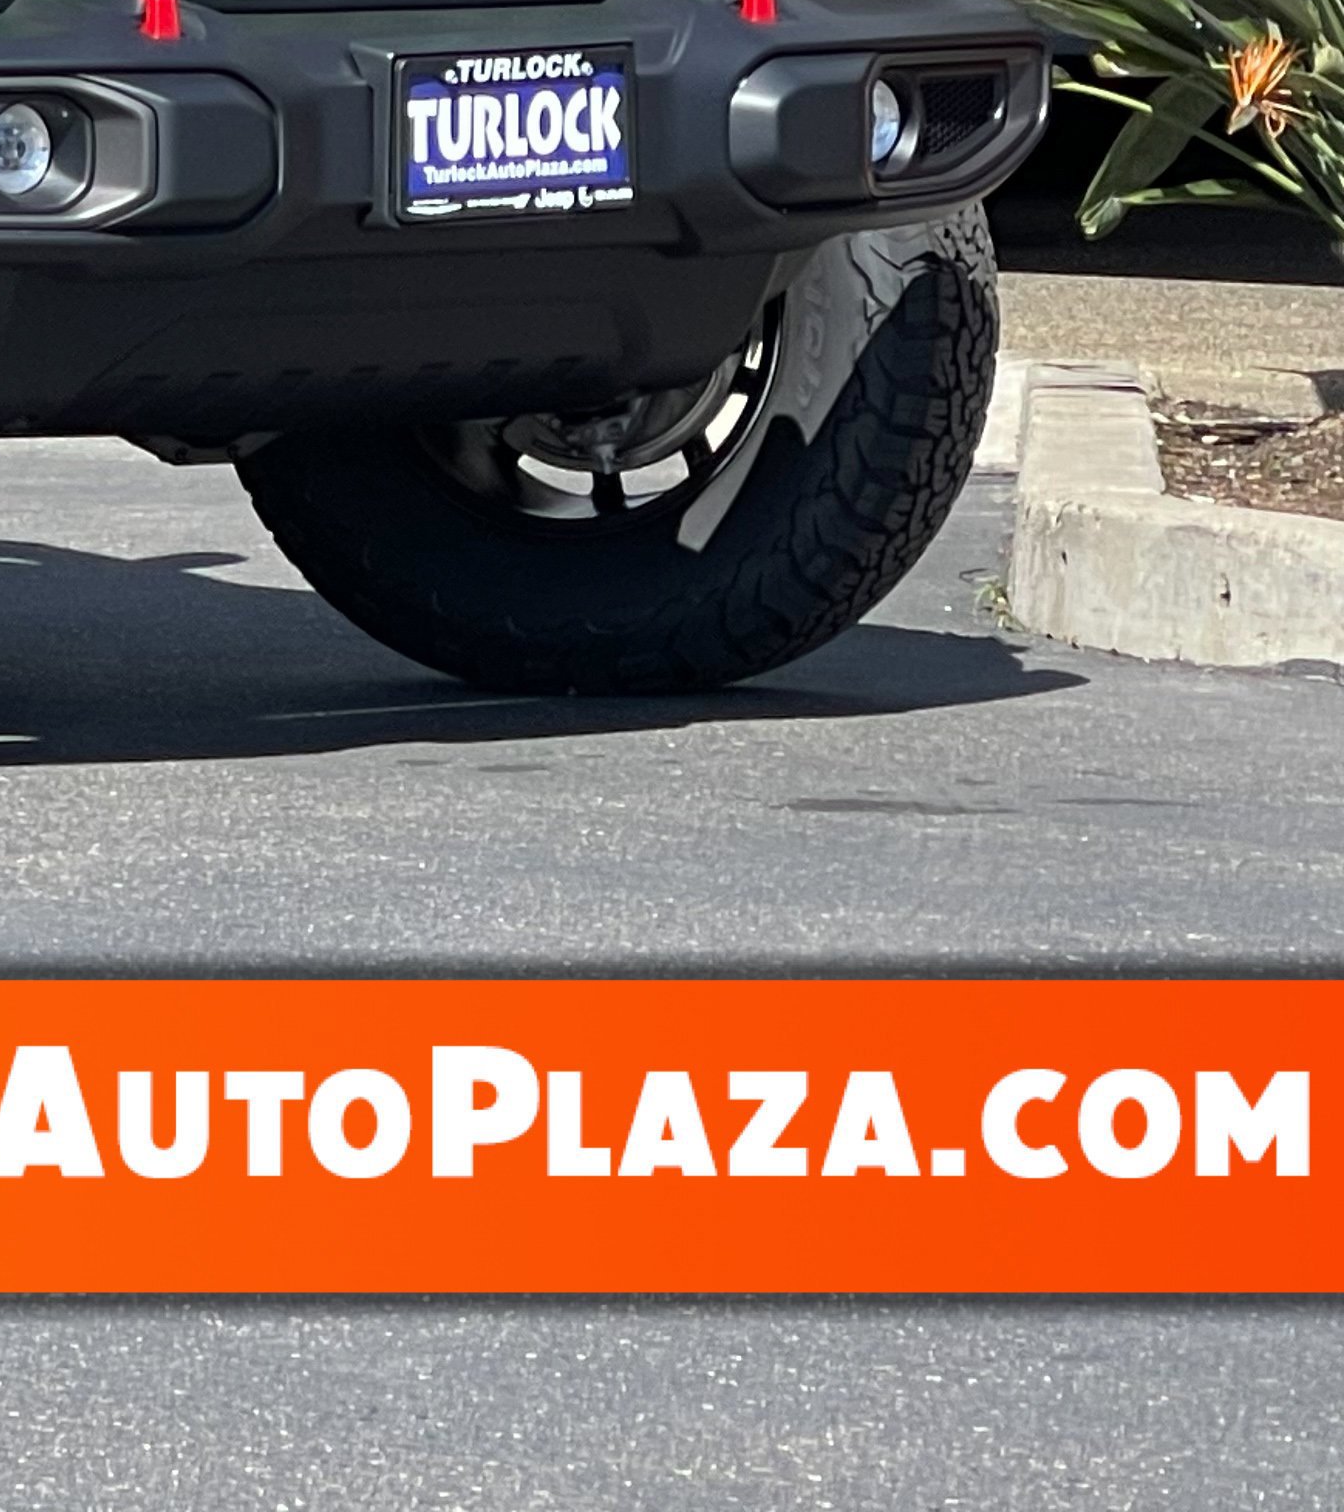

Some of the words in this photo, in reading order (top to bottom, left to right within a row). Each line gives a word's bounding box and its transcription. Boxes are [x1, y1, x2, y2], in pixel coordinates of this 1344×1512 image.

[456, 53, 583, 84] TURLOCK
[407, 86, 621, 164] TURLOCK
[423, 157, 609, 185] TurlockAutoPlaza.com
